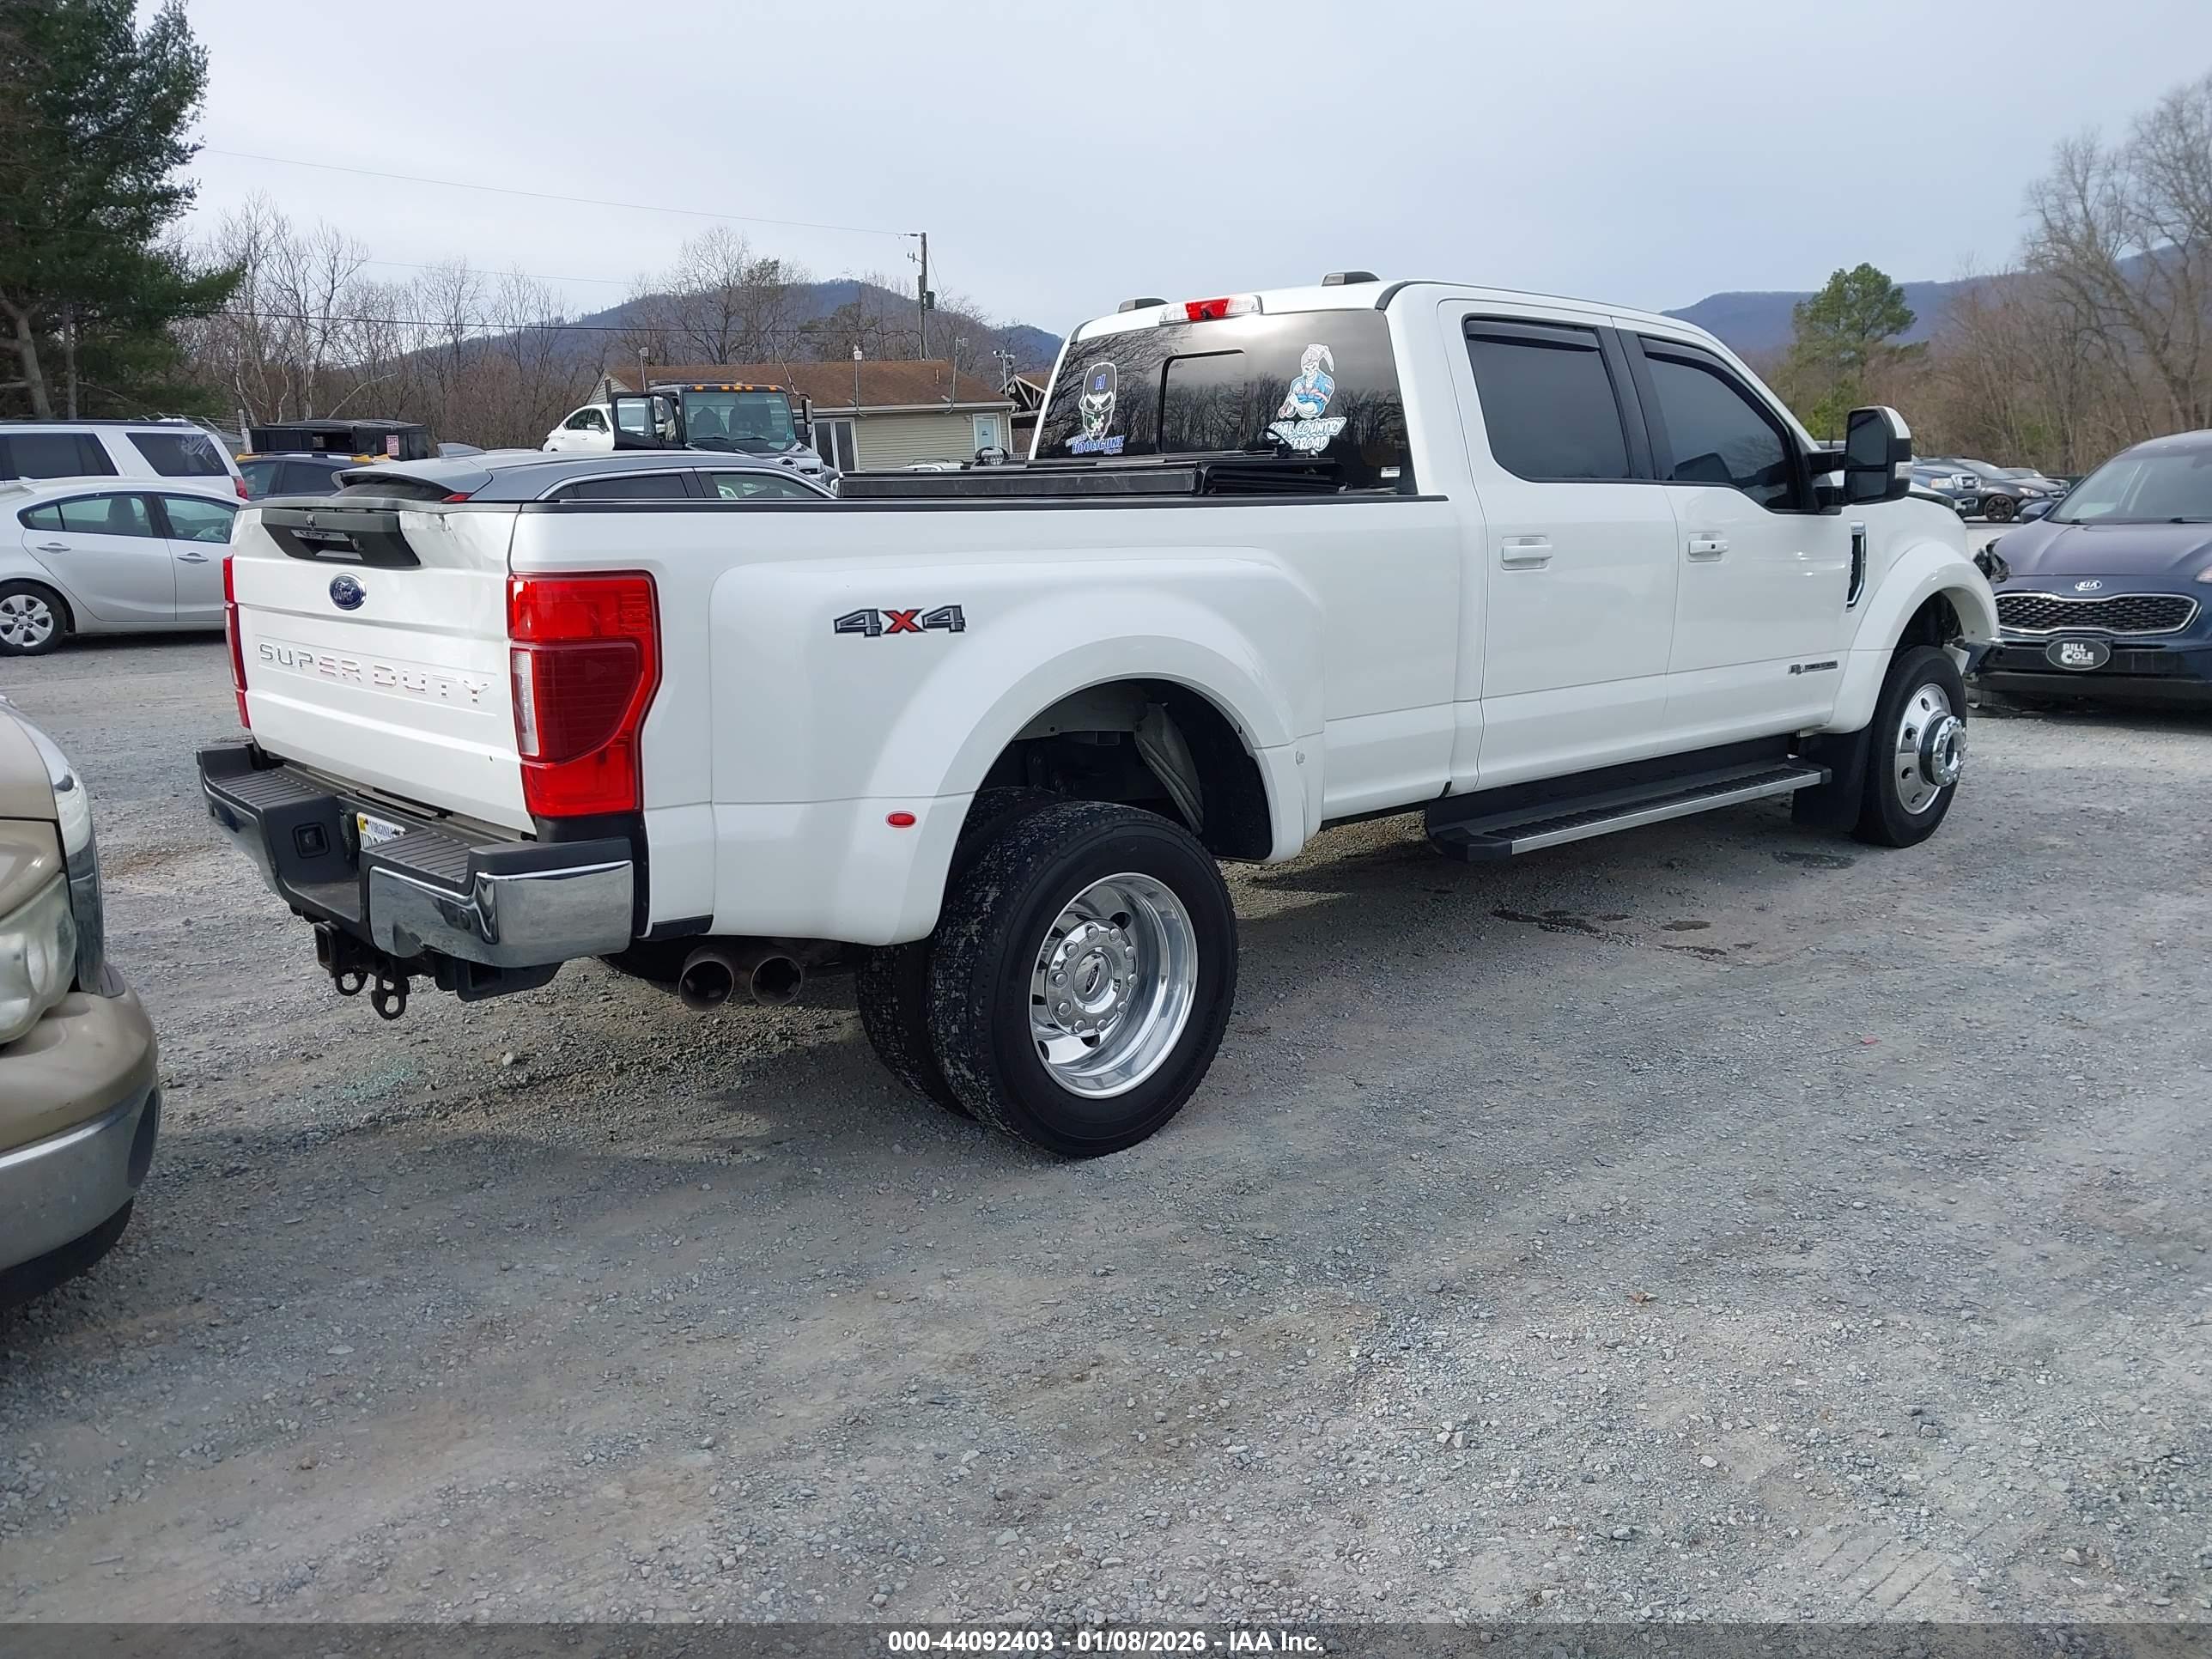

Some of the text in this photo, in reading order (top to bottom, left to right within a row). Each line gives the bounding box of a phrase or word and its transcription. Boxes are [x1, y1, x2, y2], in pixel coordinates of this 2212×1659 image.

[1296, 416, 1346, 436] COUNTRY
[1072, 435, 1124, 454] HOOLIGUNZ
[1279, 435, 1330, 452] FFROAD
[331, 580, 357, 603] Ford
[2076, 580, 2100, 591] KIA
[2063, 643, 2087, 652] BILL
[2061, 650, 2094, 664] COLE
[259, 643, 490, 703] SUPER DUTY
